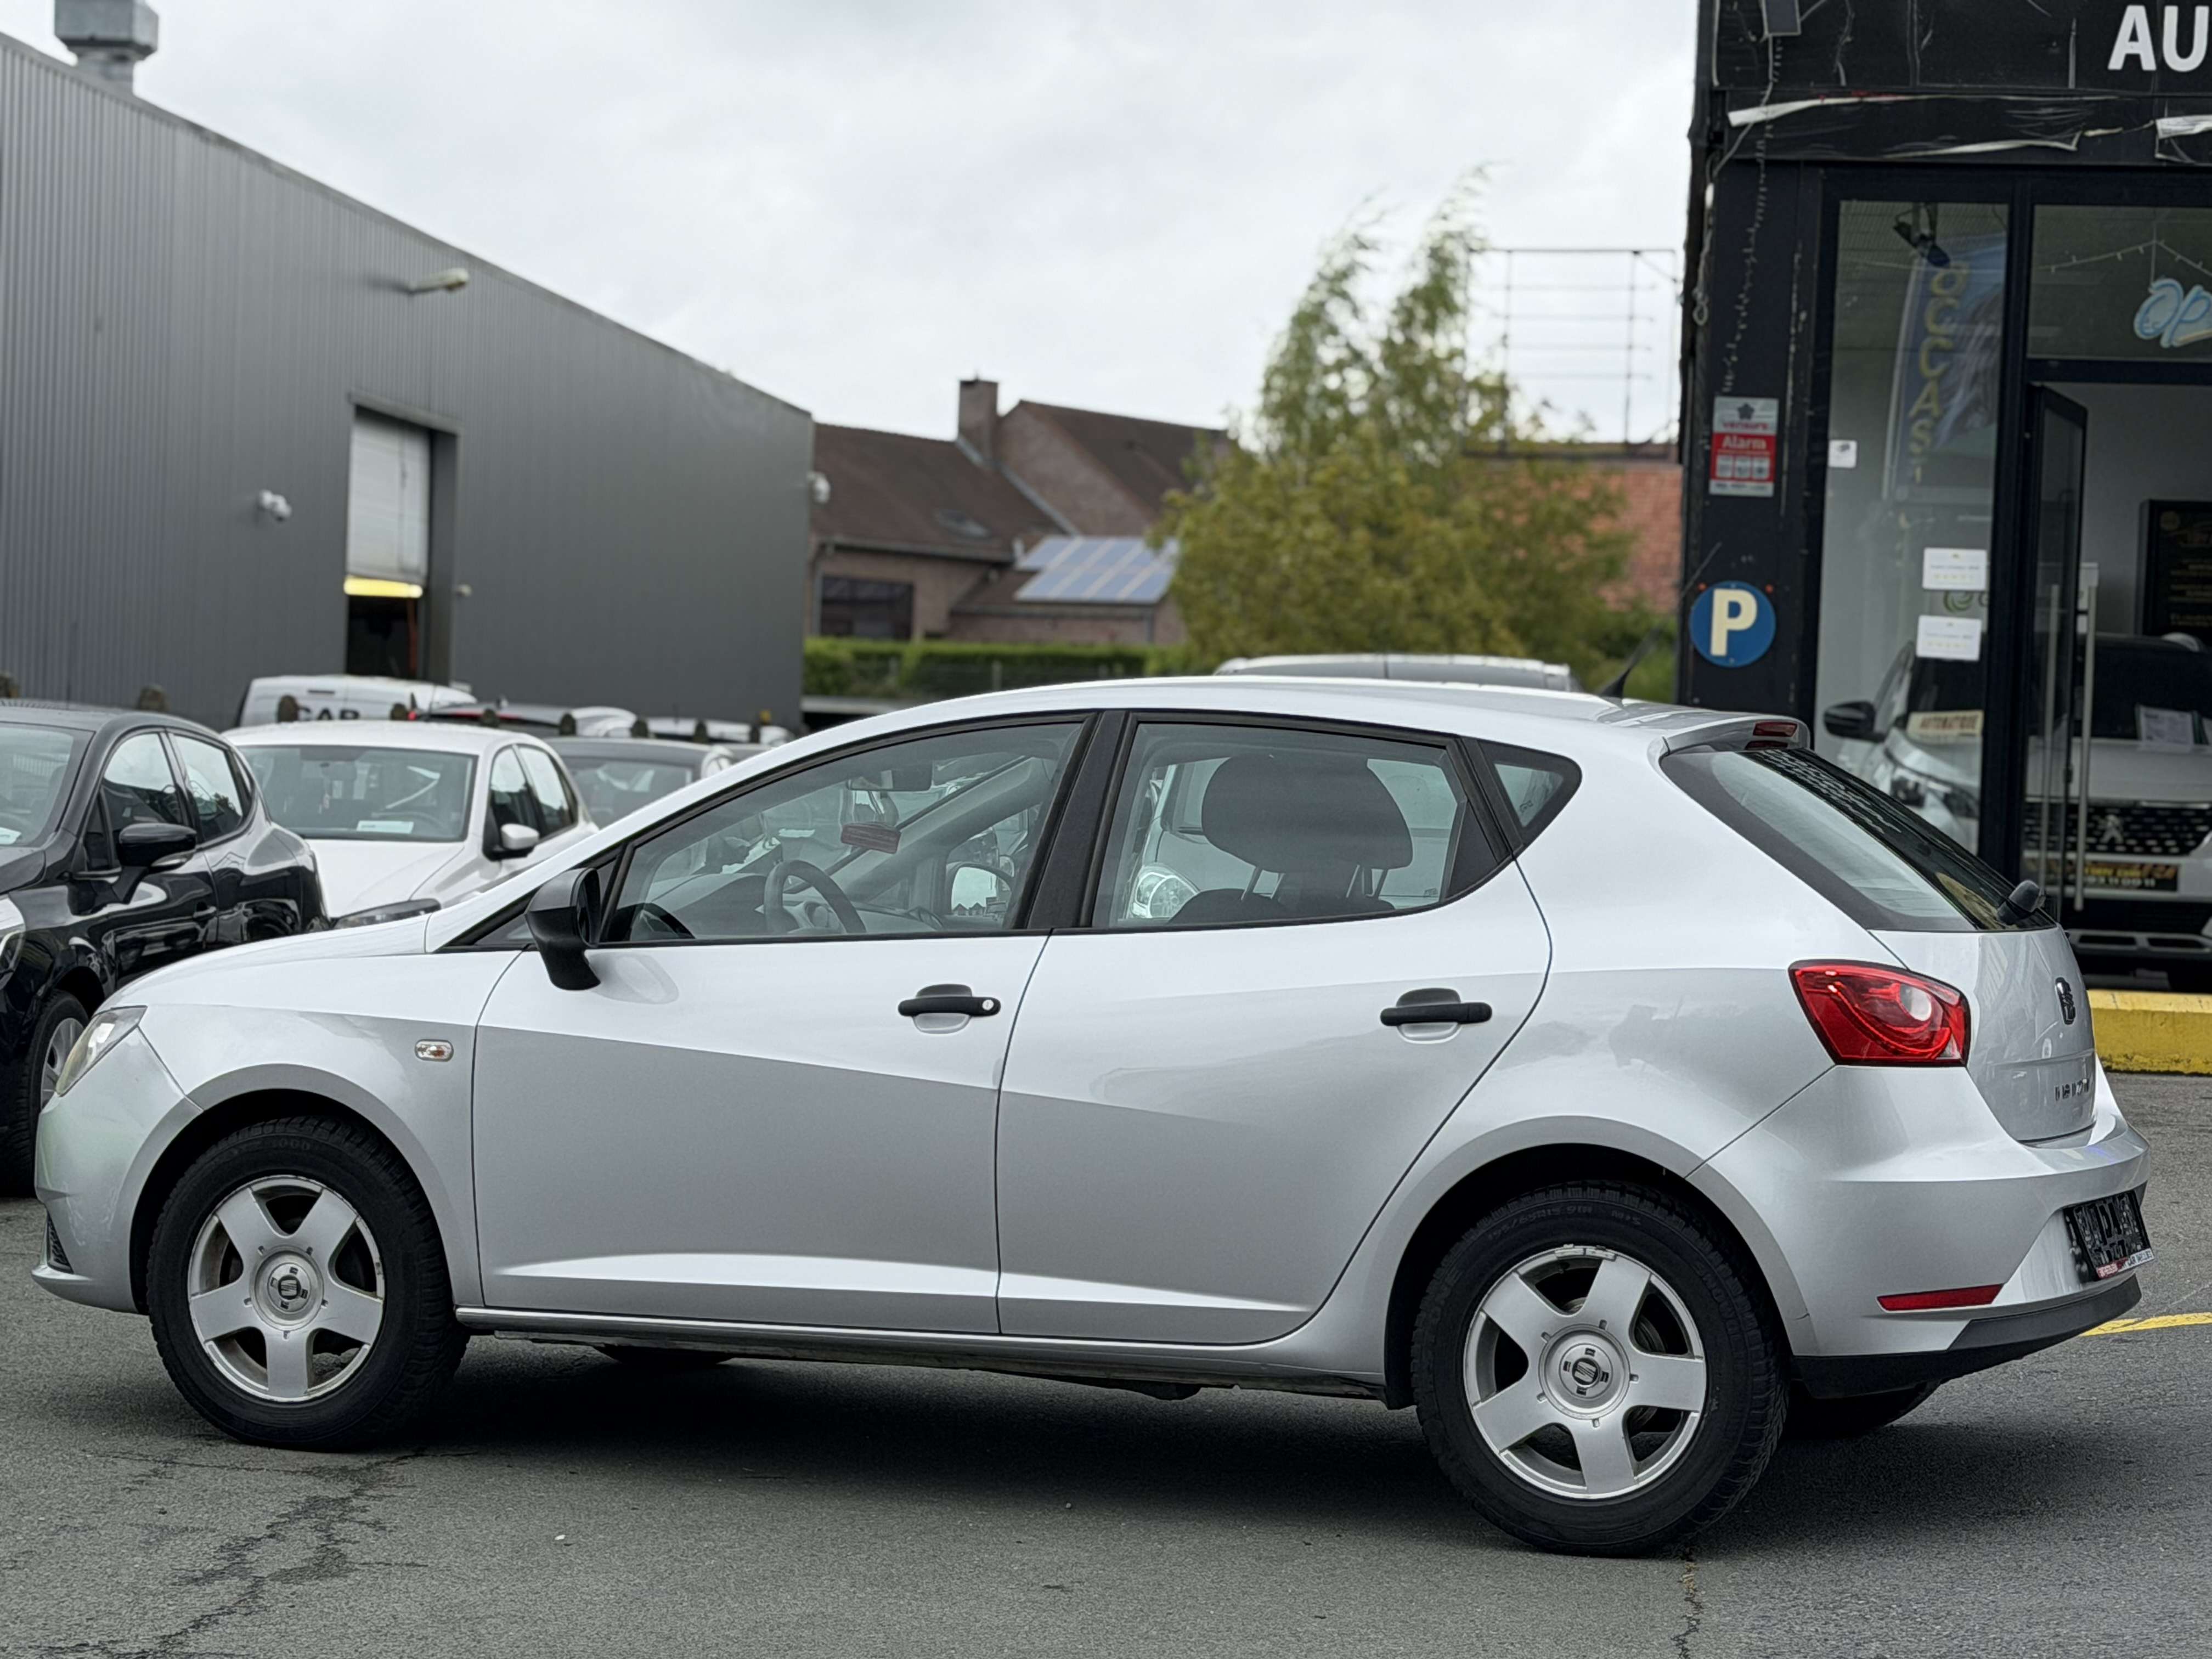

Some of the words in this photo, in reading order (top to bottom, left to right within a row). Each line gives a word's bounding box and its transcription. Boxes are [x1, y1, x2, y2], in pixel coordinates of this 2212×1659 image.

[2107, 4, 2210, 72] AU
[1722, 435, 1767, 450] Alarm
[1711, 588, 1758, 657] P
